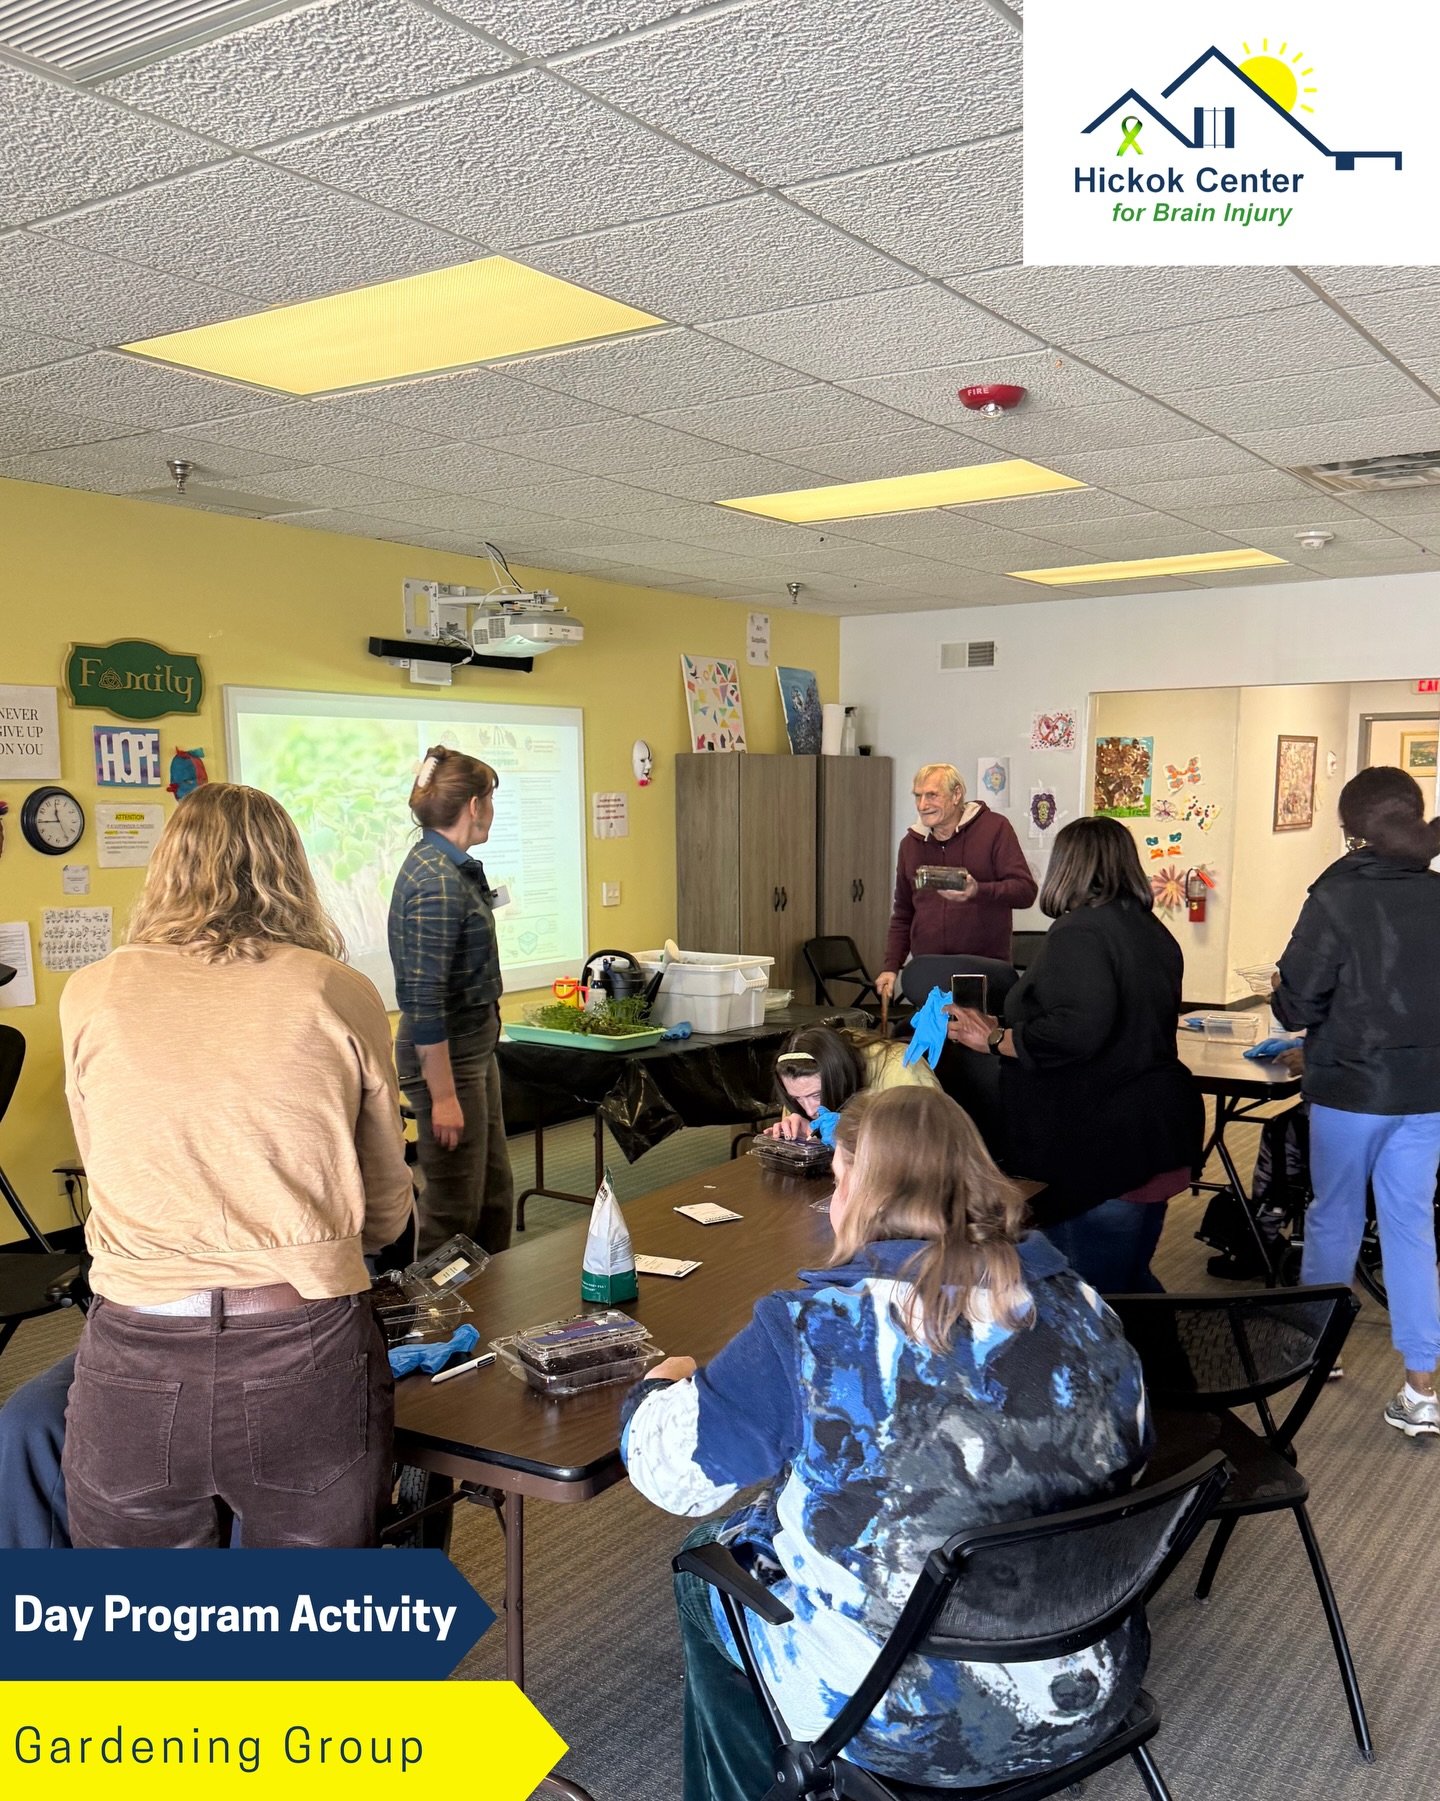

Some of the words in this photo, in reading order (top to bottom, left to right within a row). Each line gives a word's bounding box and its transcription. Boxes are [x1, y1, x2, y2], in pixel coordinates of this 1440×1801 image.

[967, 387, 989, 396] FIRE
[78, 657, 194, 703] Family
[0, 725, 24, 738] IVE
[27, 726, 43, 738] UP
[17, 743, 44, 755] YOU
[100, 731, 161, 785] HOPE
[115, 813, 145, 821] ATTENTION
